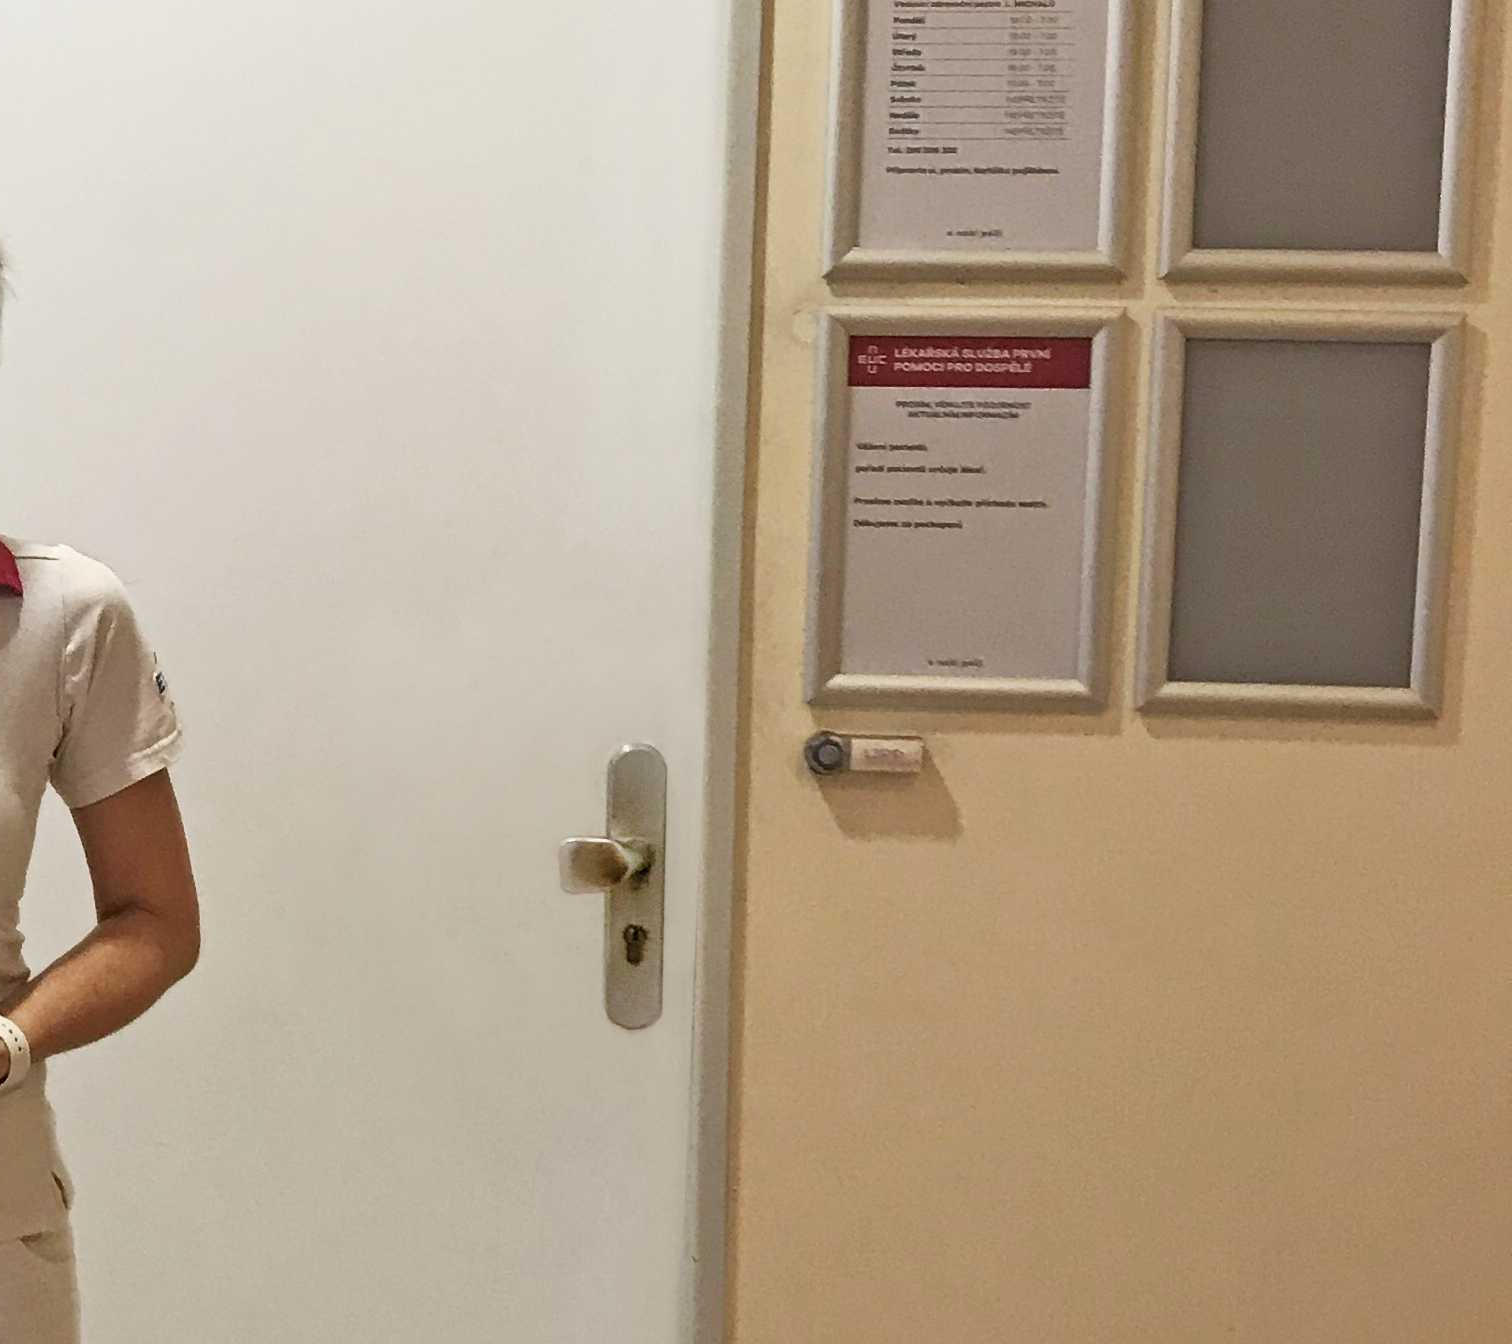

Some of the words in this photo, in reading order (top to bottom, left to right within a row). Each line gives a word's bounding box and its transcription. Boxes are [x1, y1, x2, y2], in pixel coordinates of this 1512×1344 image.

[894, 346, 958, 359] LÉKAŘSKÁ
[962, 347, 1009, 359] SLUŽBA
[1012, 348, 1052, 360] PRVNÍ
[893, 362, 944, 372] POMOCI
[947, 362, 972, 372] PRO
[975, 361, 1033, 373] DOSPĚLÉ
